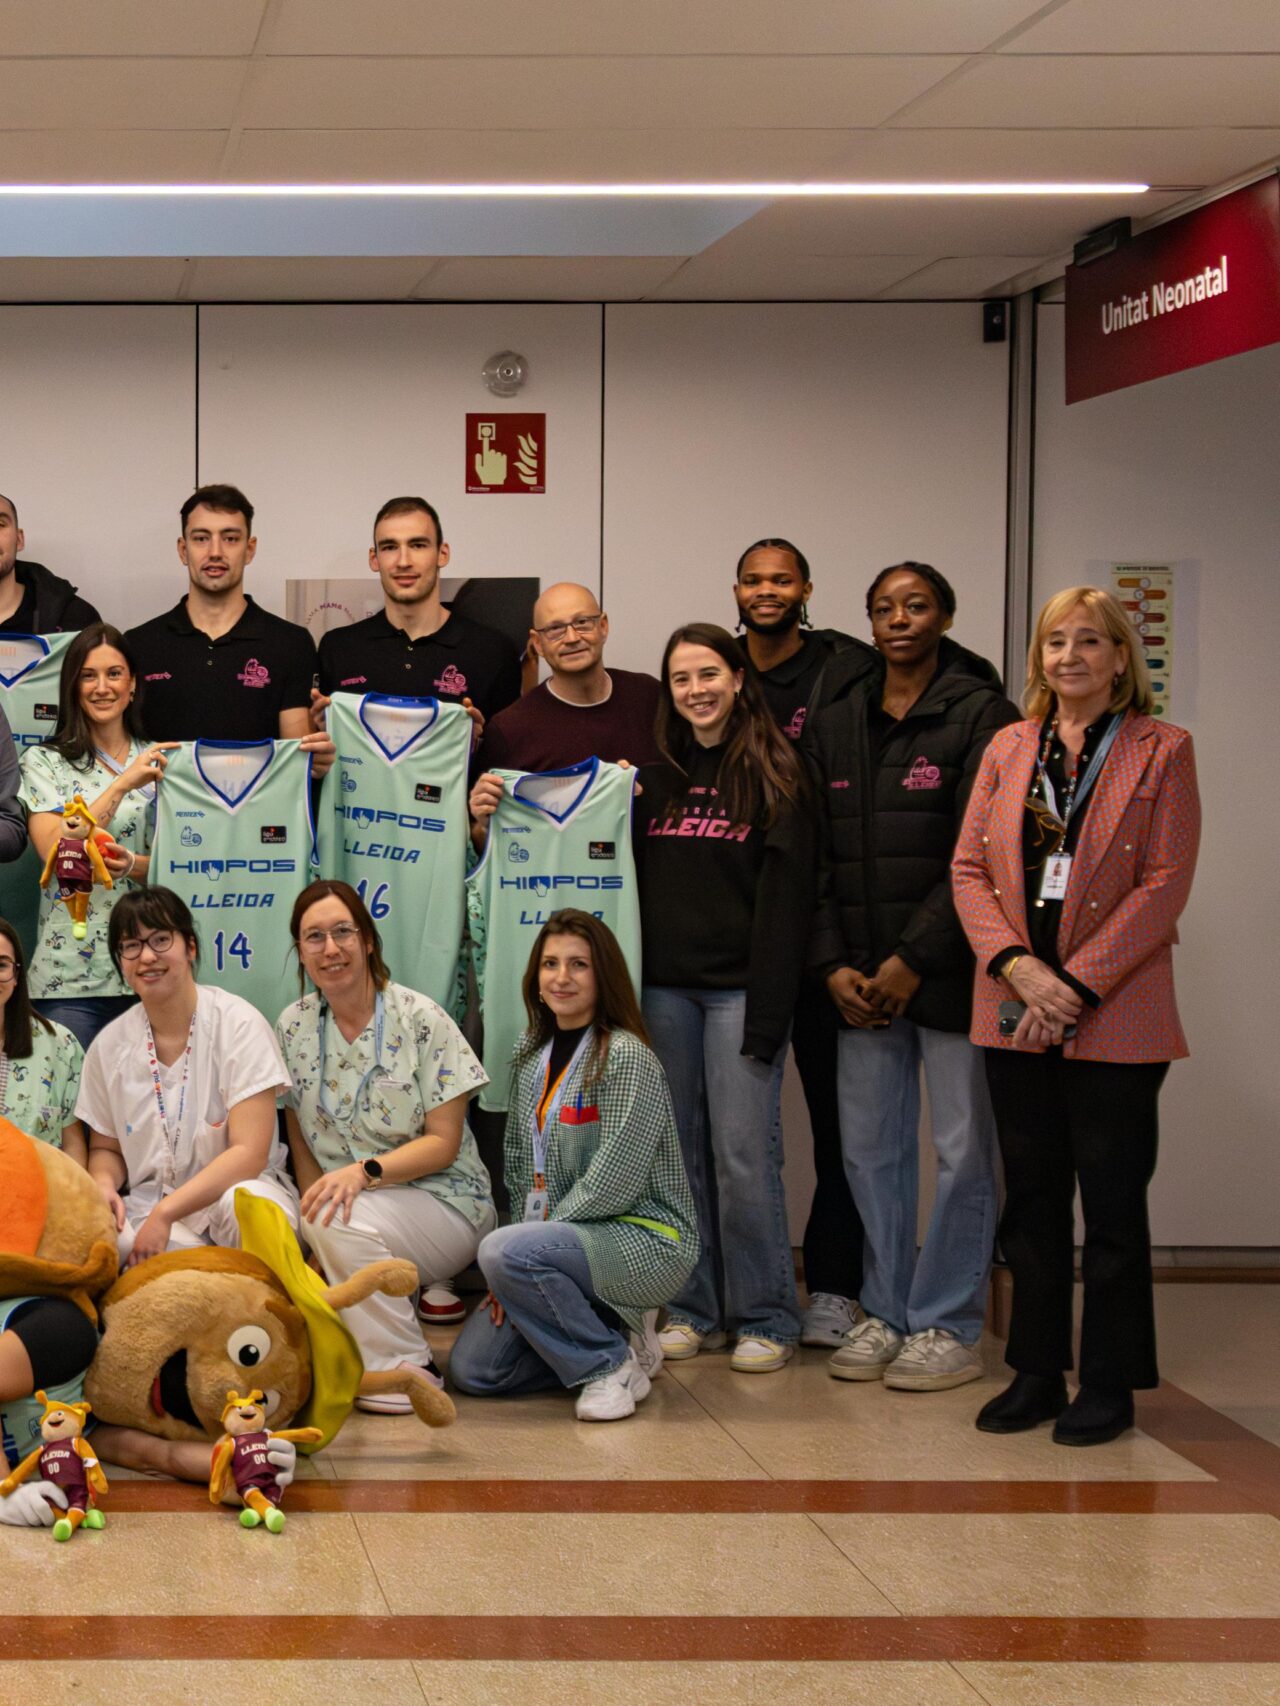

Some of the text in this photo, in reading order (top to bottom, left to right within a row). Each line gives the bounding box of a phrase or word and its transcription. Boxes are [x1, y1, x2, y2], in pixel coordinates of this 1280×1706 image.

[1102, 255, 1229, 335] Unitat Neonatal
[343, 838, 421, 864] LLEIDA
[63, 860, 74, 869] 00
[170, 859, 296, 874] HIOPOS
[500, 875, 624, 890] HIOPOS
[190, 893, 275, 909] LLEIDA
[214, 930, 253, 972] 14
[41, 1450, 71, 1463] LLEIDA
[47, 1461, 60, 1475] 00
